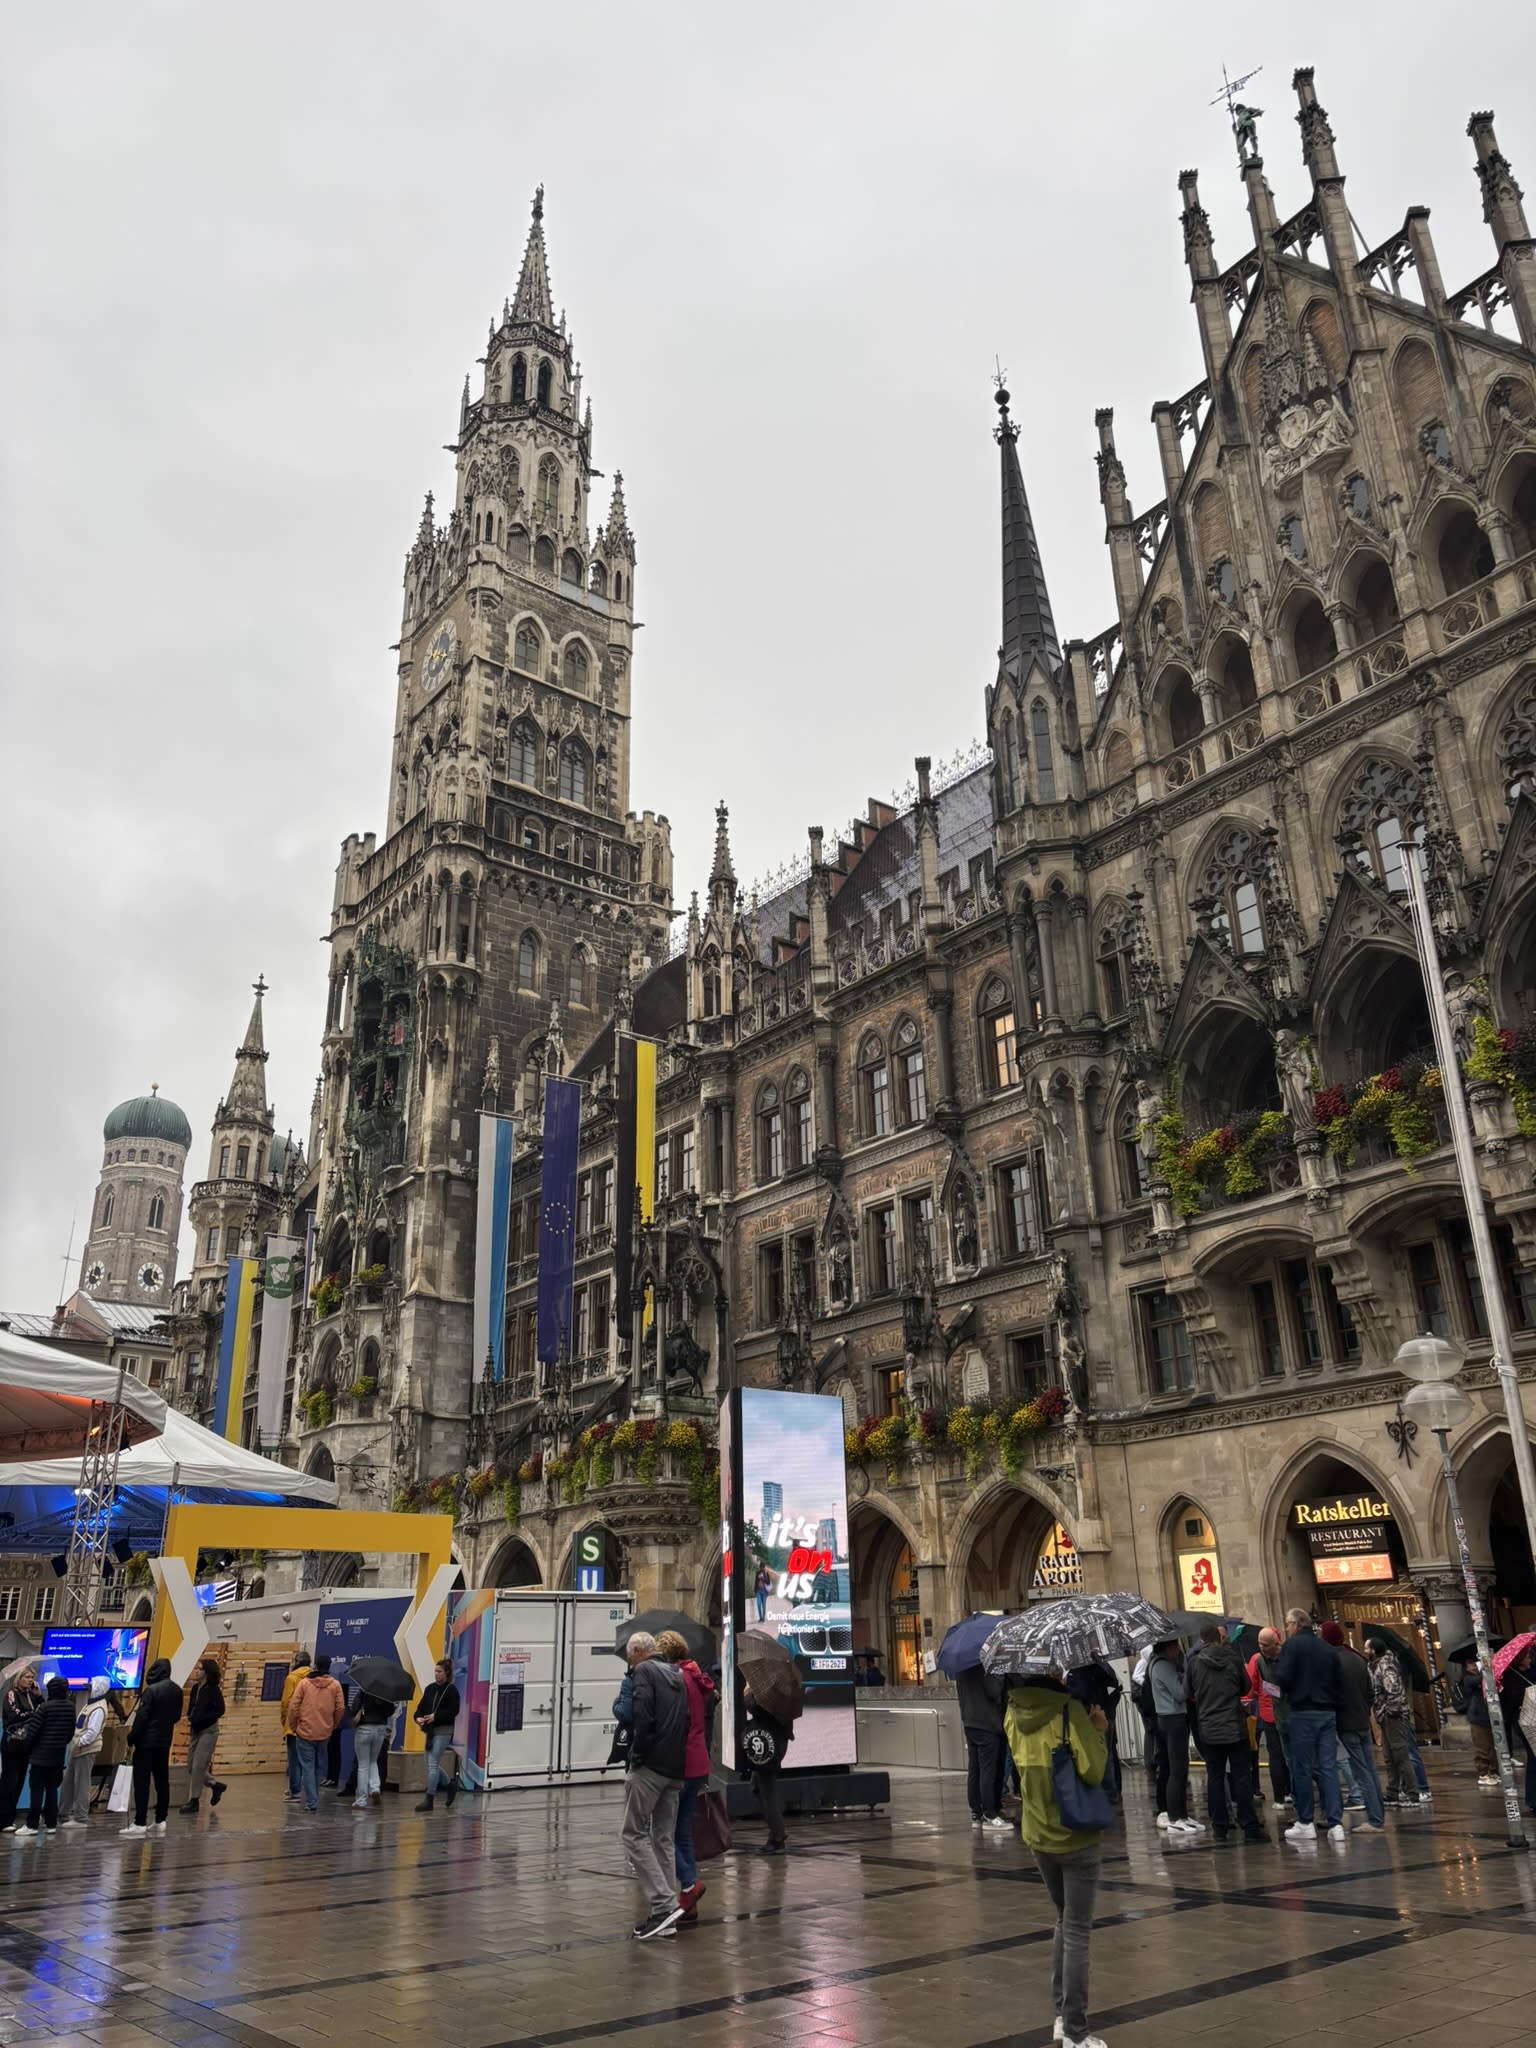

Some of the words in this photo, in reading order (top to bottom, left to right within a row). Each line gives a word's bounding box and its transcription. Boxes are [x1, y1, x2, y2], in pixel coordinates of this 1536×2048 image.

[1295, 1498, 1391, 1524] Ratskeller
[767, 1513, 818, 1548] it's
[1310, 1527, 1384, 1542] RESTAURANT
[583, 1536, 600, 1562] S
[787, 1548, 833, 1575] on
[582, 1570, 598, 1592] U
[776, 1573, 816, 1599] us
[778, 1623, 819, 1634] fktioniert.
